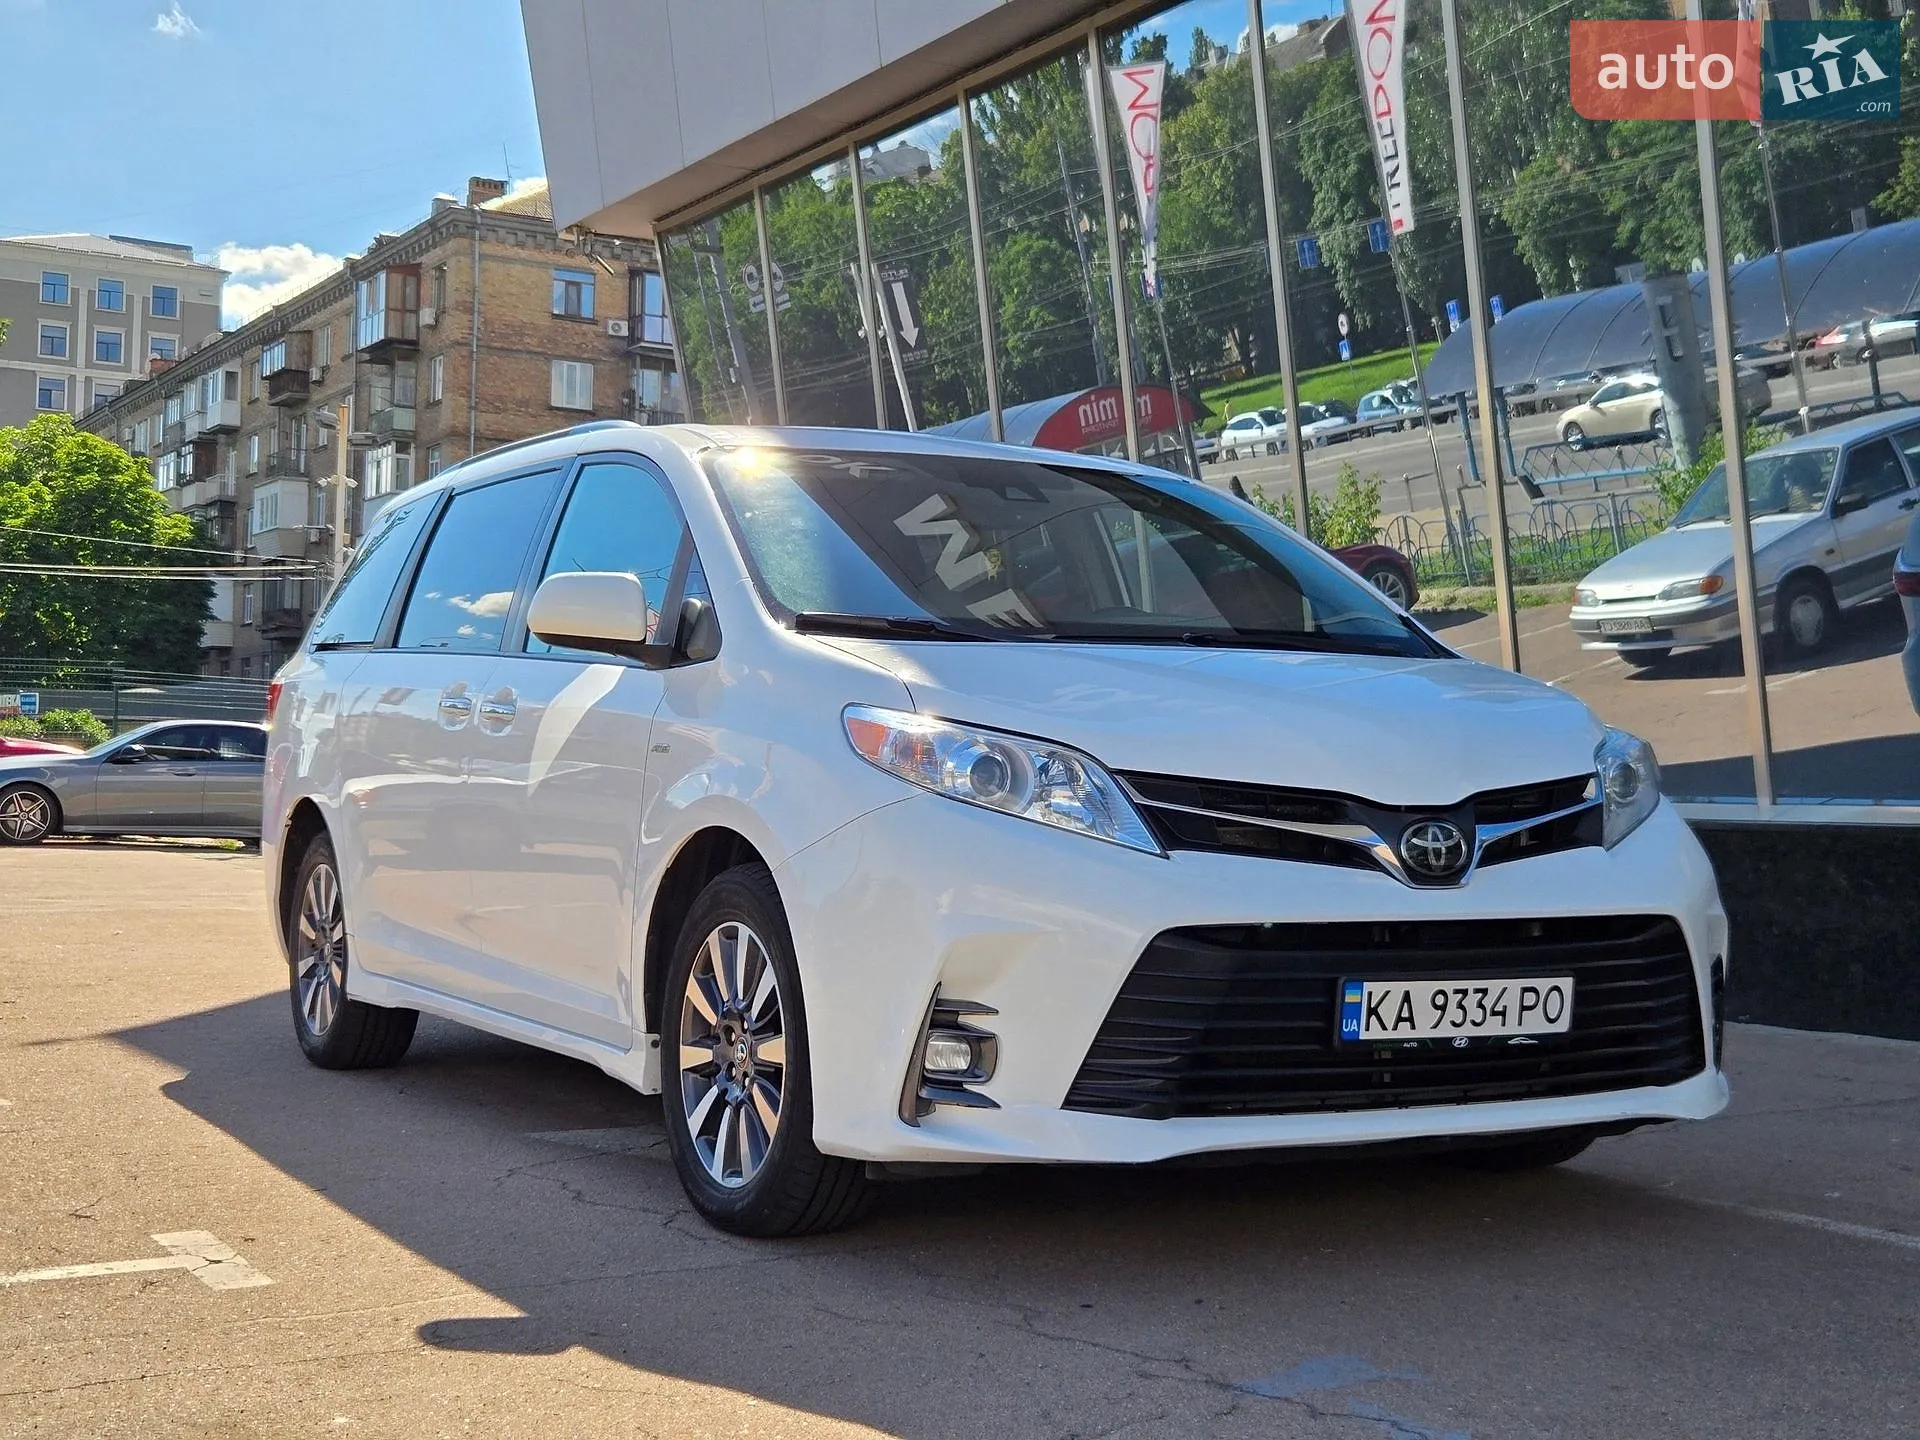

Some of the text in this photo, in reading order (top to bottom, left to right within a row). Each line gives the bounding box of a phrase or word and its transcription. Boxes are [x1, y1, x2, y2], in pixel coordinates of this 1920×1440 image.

[1364, 984, 1565, 1032] KA 9334 PO
[1342, 1018, 1359, 1032] UA
